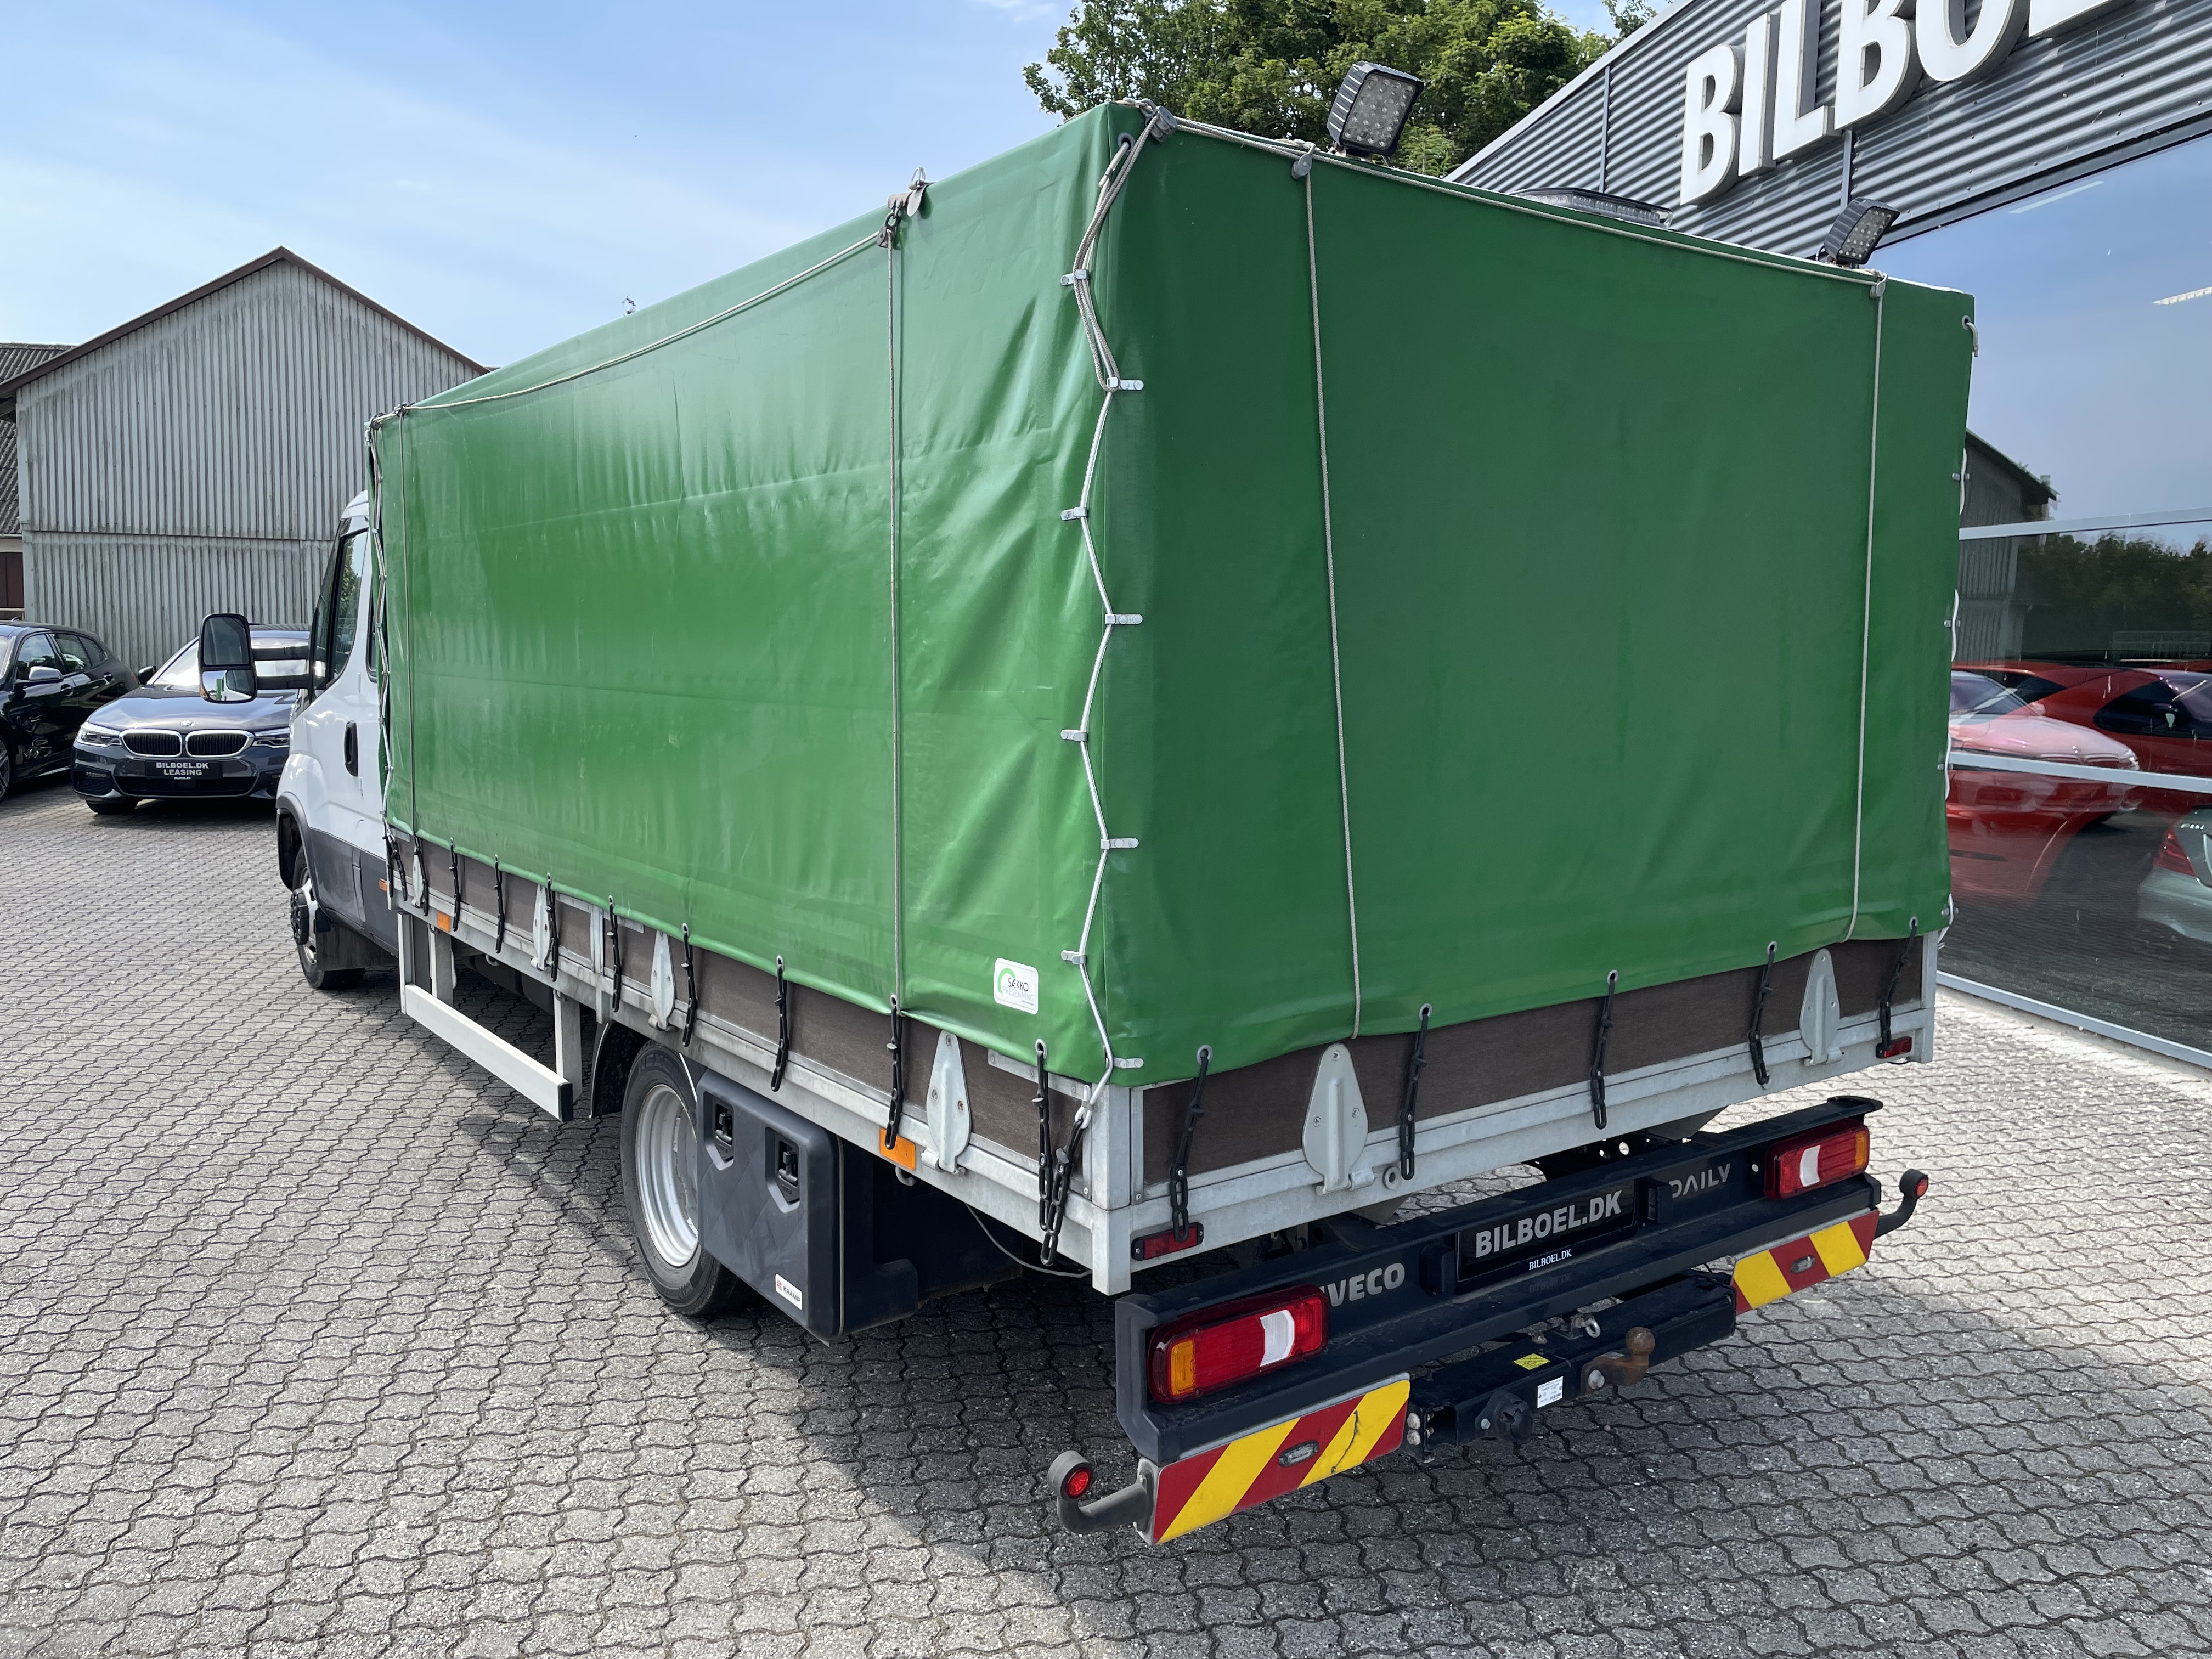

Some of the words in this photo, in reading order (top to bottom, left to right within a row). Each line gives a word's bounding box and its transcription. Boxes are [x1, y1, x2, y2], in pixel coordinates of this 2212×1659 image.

[1680, 0, 2111, 205] BILB
[1002, 985, 1034, 1002] PRESENNING
[1008, 977, 1029, 992] SÆKKO
[1668, 1163, 1731, 1199] DAILY
[1475, 1190, 1622, 1258] BILBOEL.DK
[1528, 1248, 1572, 1271] BILBOEL.DK
[1318, 1262, 1406, 1307] VECO
